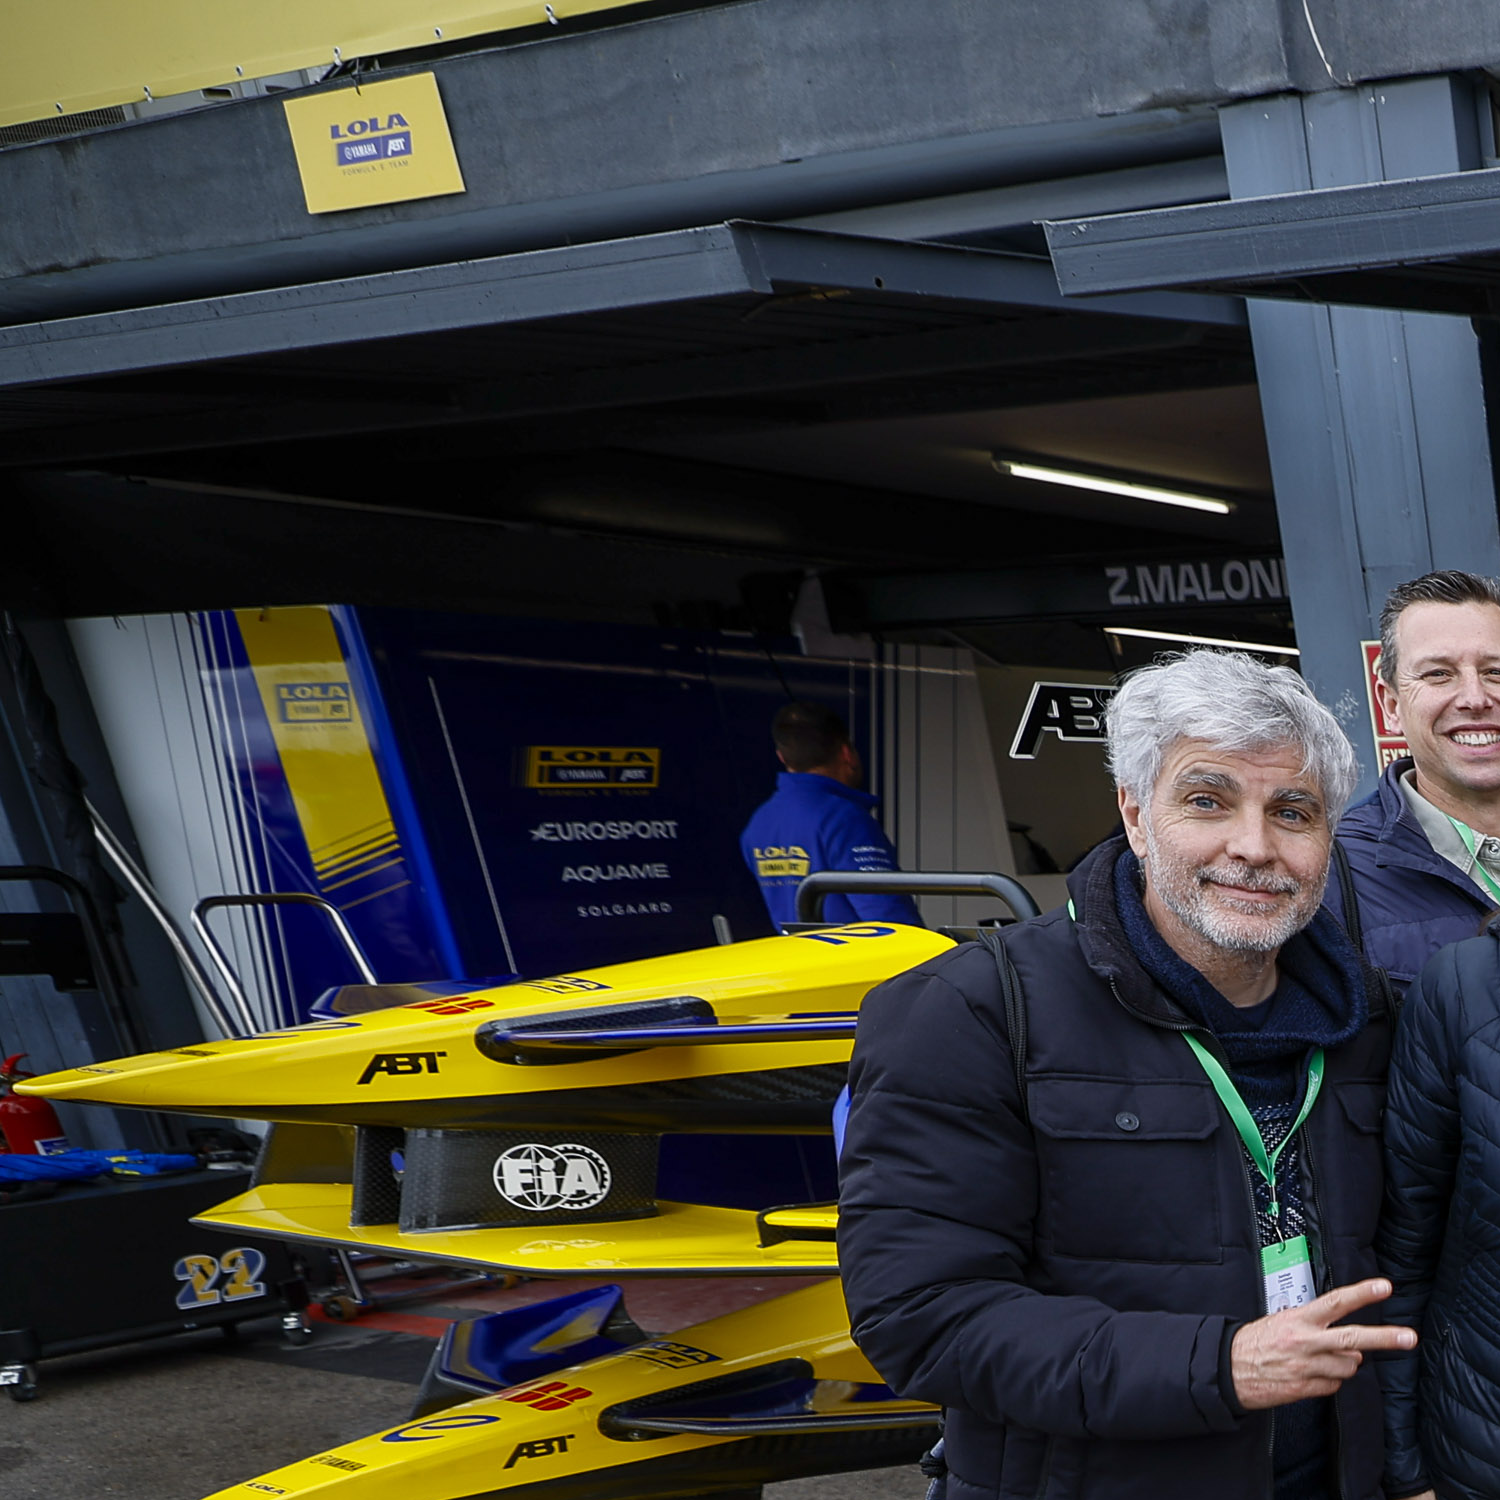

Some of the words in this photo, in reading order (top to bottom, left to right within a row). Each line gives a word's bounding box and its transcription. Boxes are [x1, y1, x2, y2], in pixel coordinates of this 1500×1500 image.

[330, 113, 409, 139] LOLA
[387, 138, 405, 156] ABT
[280, 686, 347, 698] LOLA
[1009, 681, 1119, 759] AB
[539, 750, 655, 763] LOLA
[541, 820, 679, 841] EUROSPORT
[753, 845, 810, 858] LOLA
[561, 863, 671, 883] AQUAME
[576, 902, 672, 918] SOLGAARD
[357, 1051, 447, 1085] ABT
[174, 1247, 266, 1310] 22
[502, 1434, 576, 1470] ABT
[247, 1482, 286, 1495] LOLA
